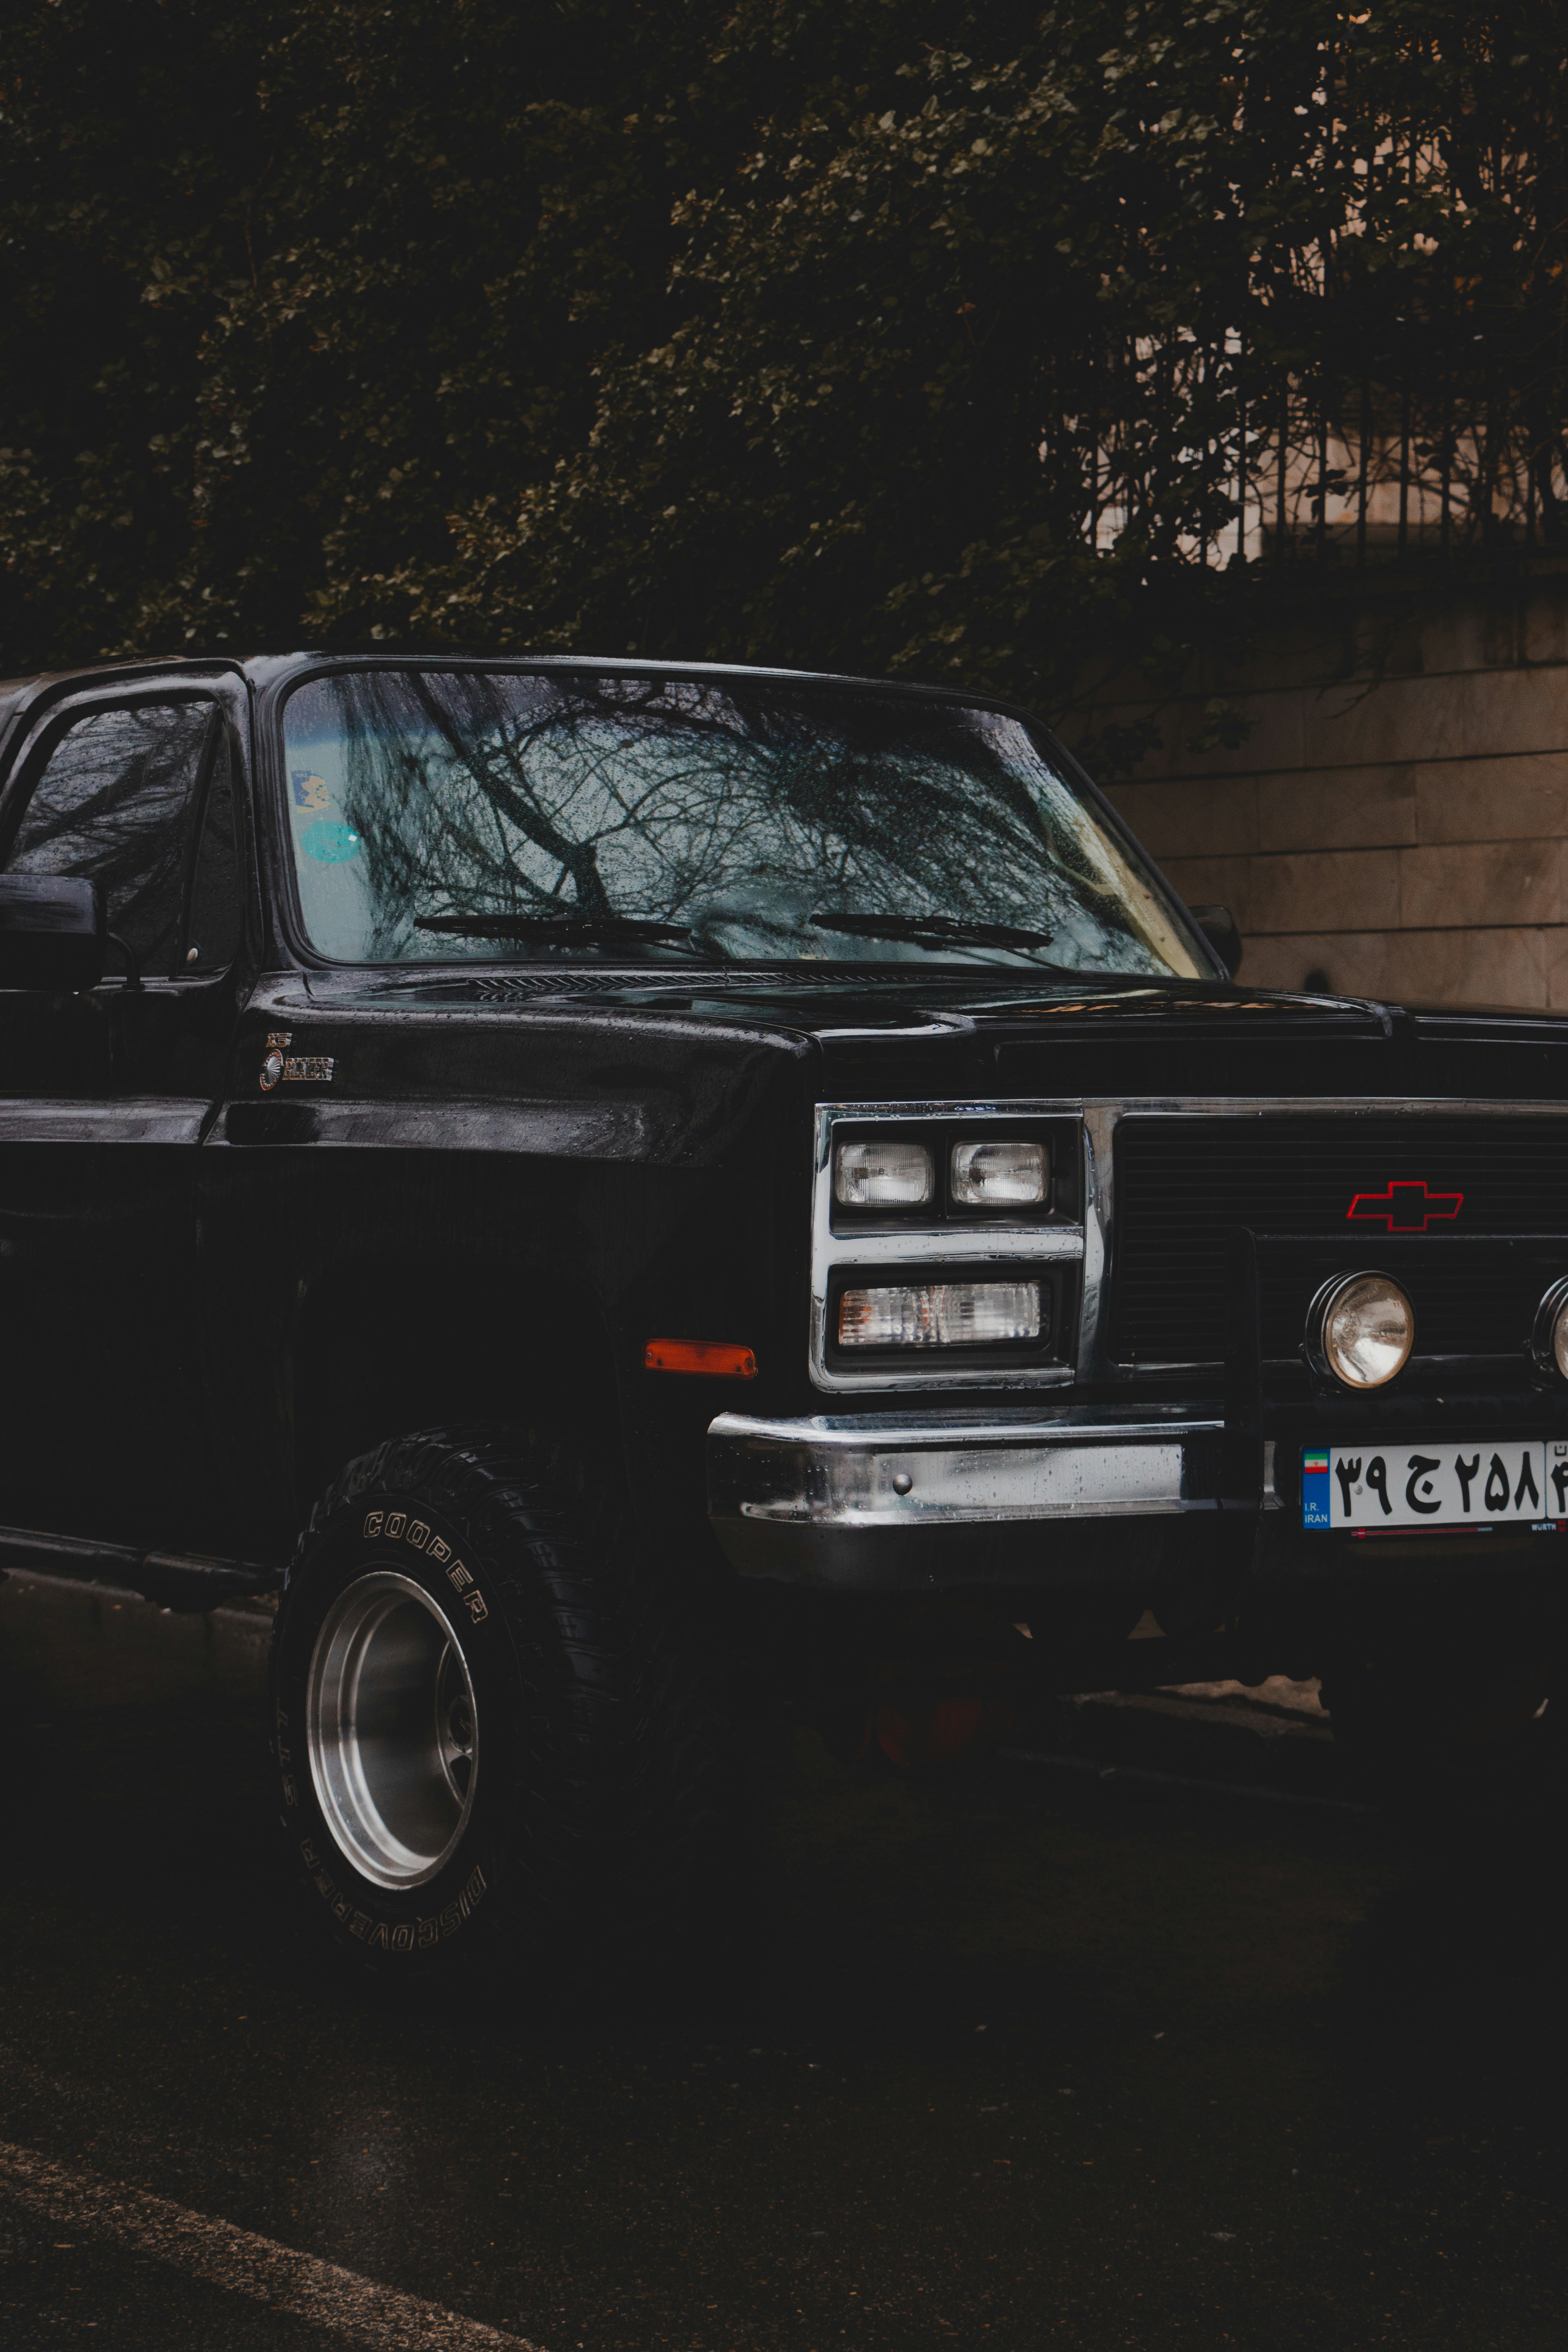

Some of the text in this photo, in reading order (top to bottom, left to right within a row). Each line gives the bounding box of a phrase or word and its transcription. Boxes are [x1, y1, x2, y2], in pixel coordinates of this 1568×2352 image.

[1305, 1503, 1319, 1511] I.R.
[1335, 1456, 1392, 1517] ۳۹
[1406, 1455, 1442, 1514] ج
[1455, 1451, 1539, 1513] ۲۵۸
[1305, 1514, 1328, 1523] IRAN
[363, 1511, 489, 1624] COOPER
[300, 1838, 487, 1952] DISCOVERER
